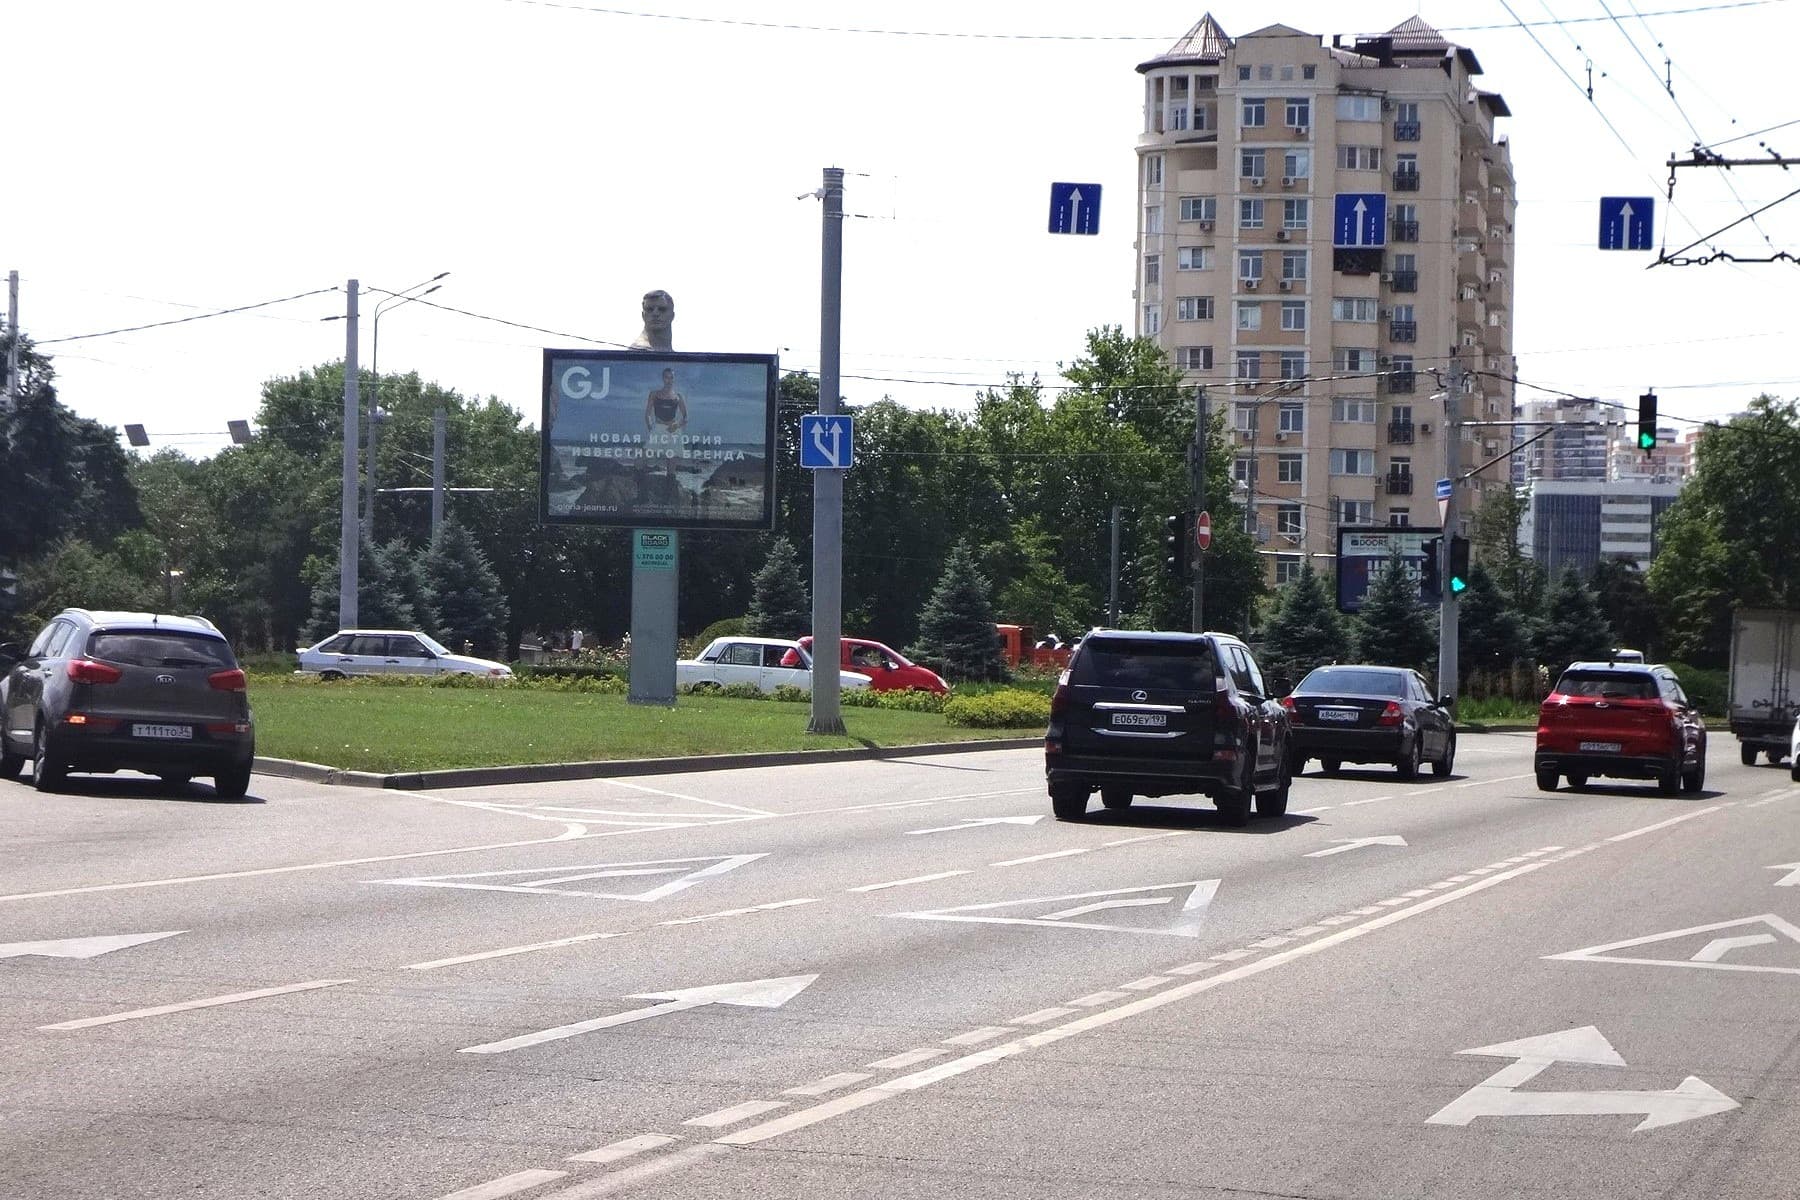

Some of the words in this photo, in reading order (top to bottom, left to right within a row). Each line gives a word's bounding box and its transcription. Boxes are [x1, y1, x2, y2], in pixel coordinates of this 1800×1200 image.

[561, 366, 610, 400] GJ
[590, 433, 641, 443] НОВАЯ
[649, 434, 722, 446] ИСТОРИЯ
[571, 447, 675, 459] ИЗВЕСТНОГО
[682, 449, 745, 461] БРЕНДА
